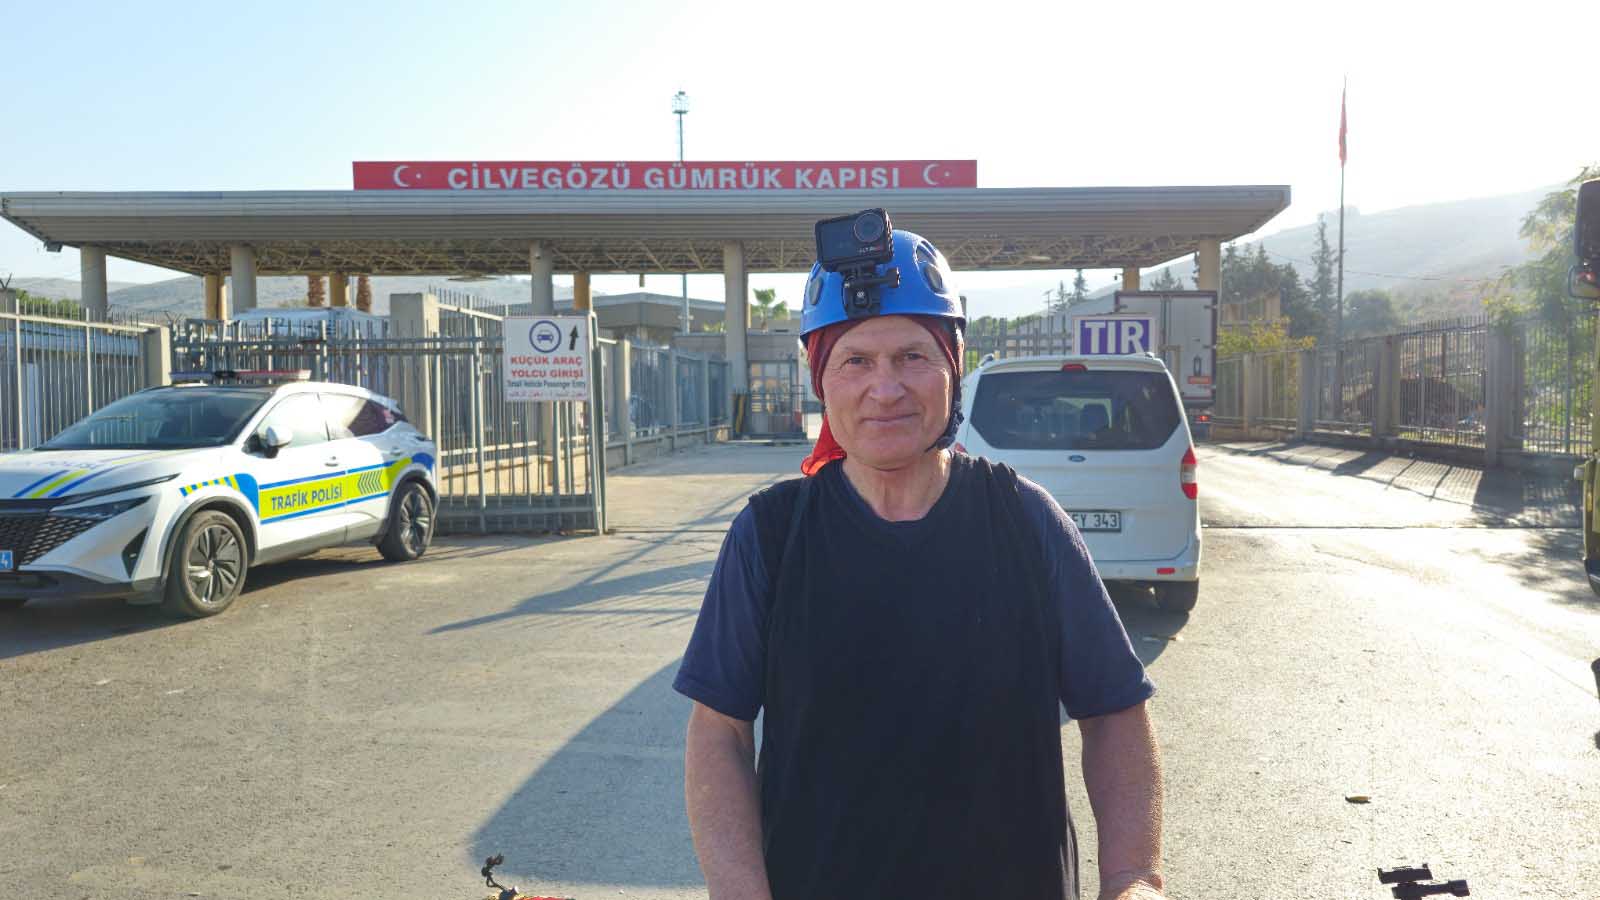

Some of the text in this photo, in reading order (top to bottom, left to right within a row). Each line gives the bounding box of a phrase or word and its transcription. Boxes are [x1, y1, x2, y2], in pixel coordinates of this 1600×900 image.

[447, 162, 900, 189] CİLVEGÖZÜ GÜMRÜK KAPISI
[1085, 321, 1145, 353] TIR
[552, 355, 582, 366] ARAÇ
[511, 368, 583, 380] YOLCU GİRİŞİ
[271, 481, 343, 512] TRAFİK POLİSİ
[1093, 514, 1118, 528] 343
